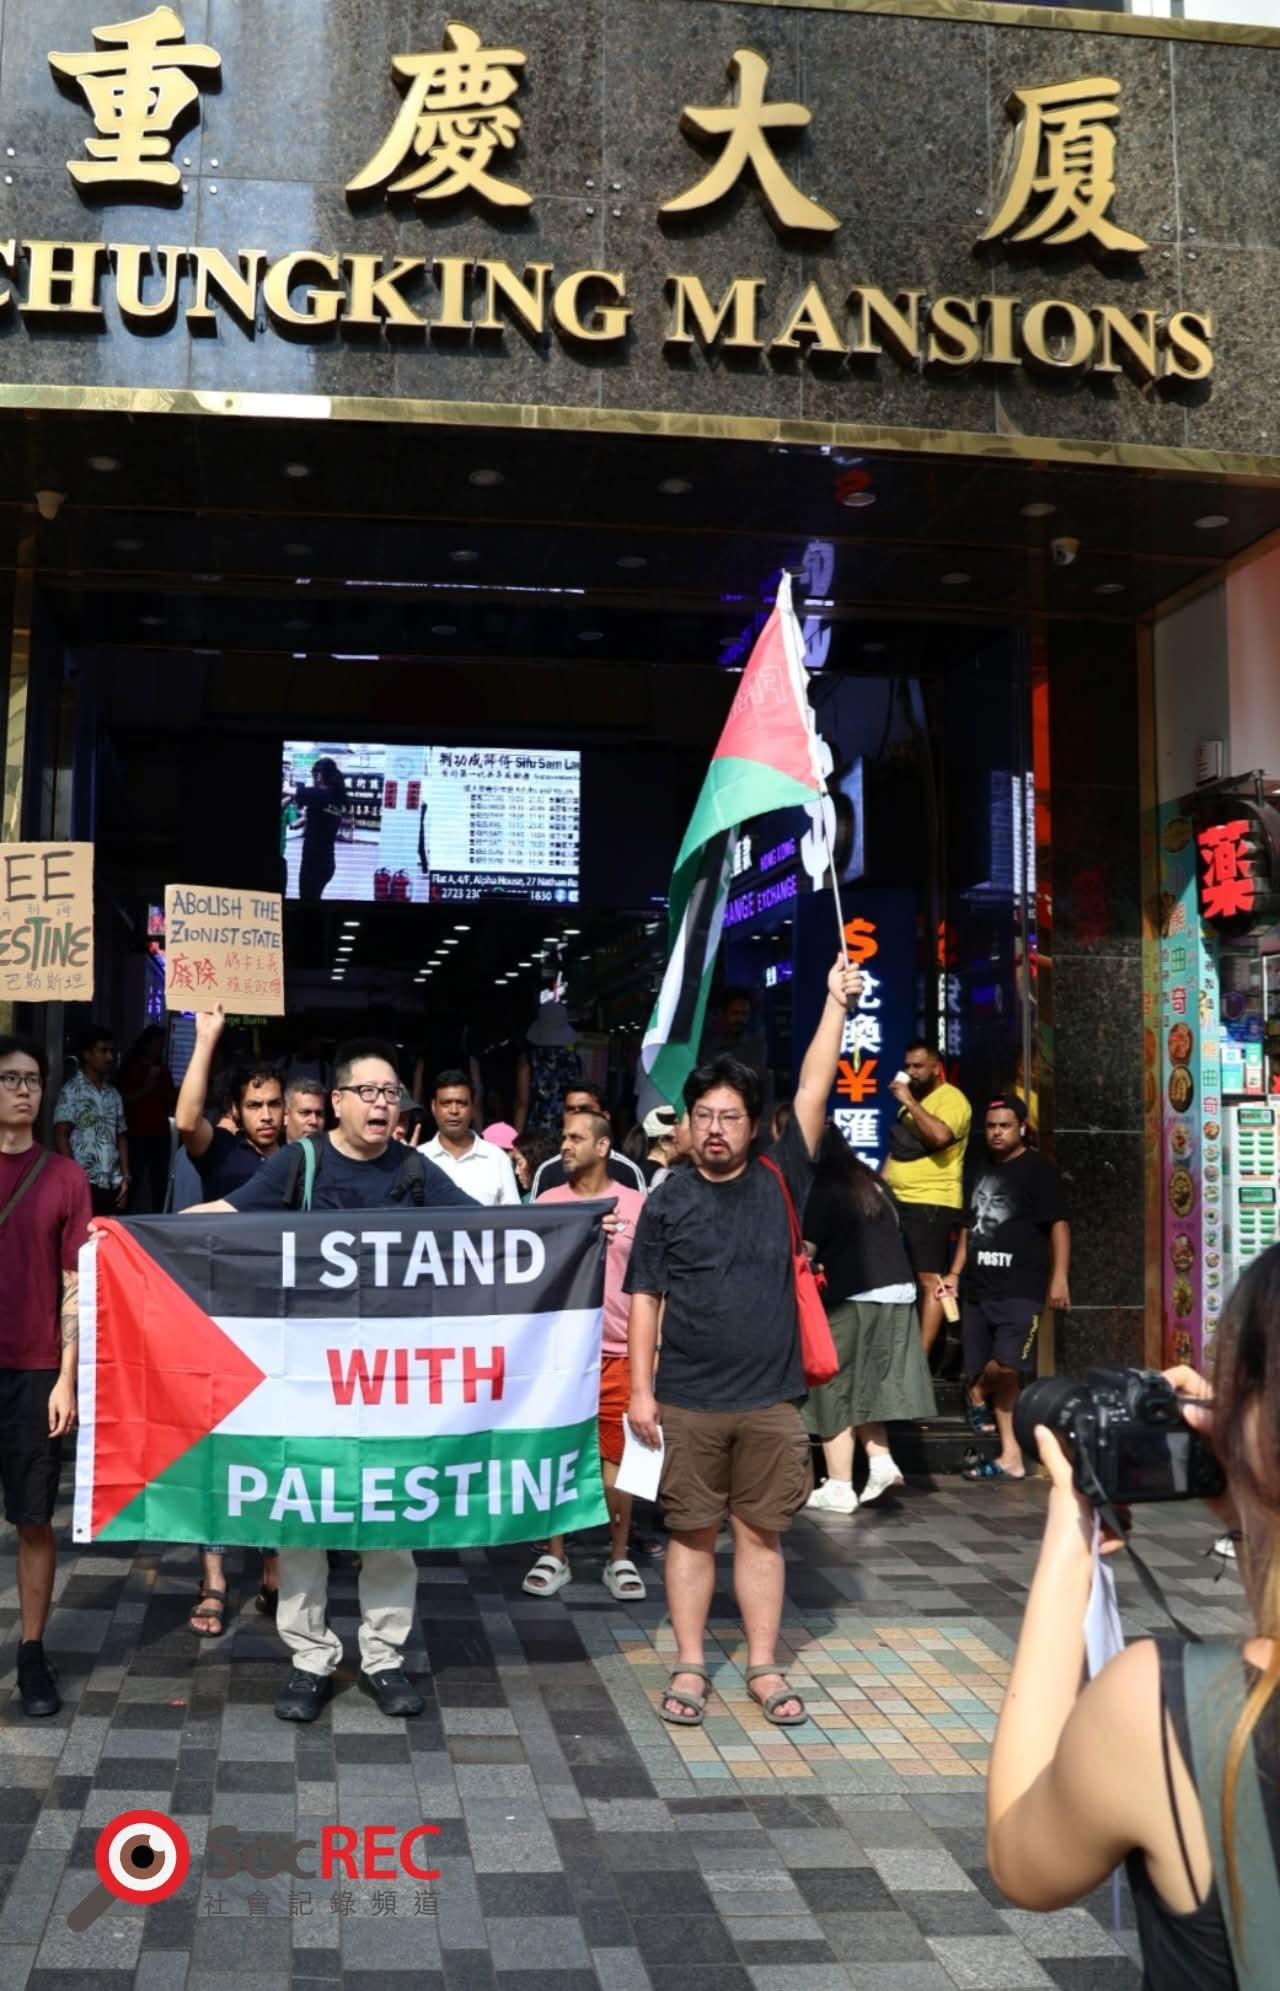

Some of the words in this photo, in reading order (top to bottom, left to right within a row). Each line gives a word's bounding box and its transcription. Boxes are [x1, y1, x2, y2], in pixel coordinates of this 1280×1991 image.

[0, 240, 634, 342] HUNGKING
[665, 275, 1215, 382] MANSIONS
[172, 890, 242, 919] ABOLISH
[251, 899, 281, 922] THE
[170, 919, 241, 945] ZIONIST
[241, 928, 281, 949] STATE
[168, 952, 218, 992] 廢除
[281, 1231, 296, 1288] I
[319, 1228, 546, 1289] STAND
[977, 1251, 1013, 1268] POSTY
[326, 1345, 506, 1406] WITH
[227, 1449, 580, 1524] PALESTINE
